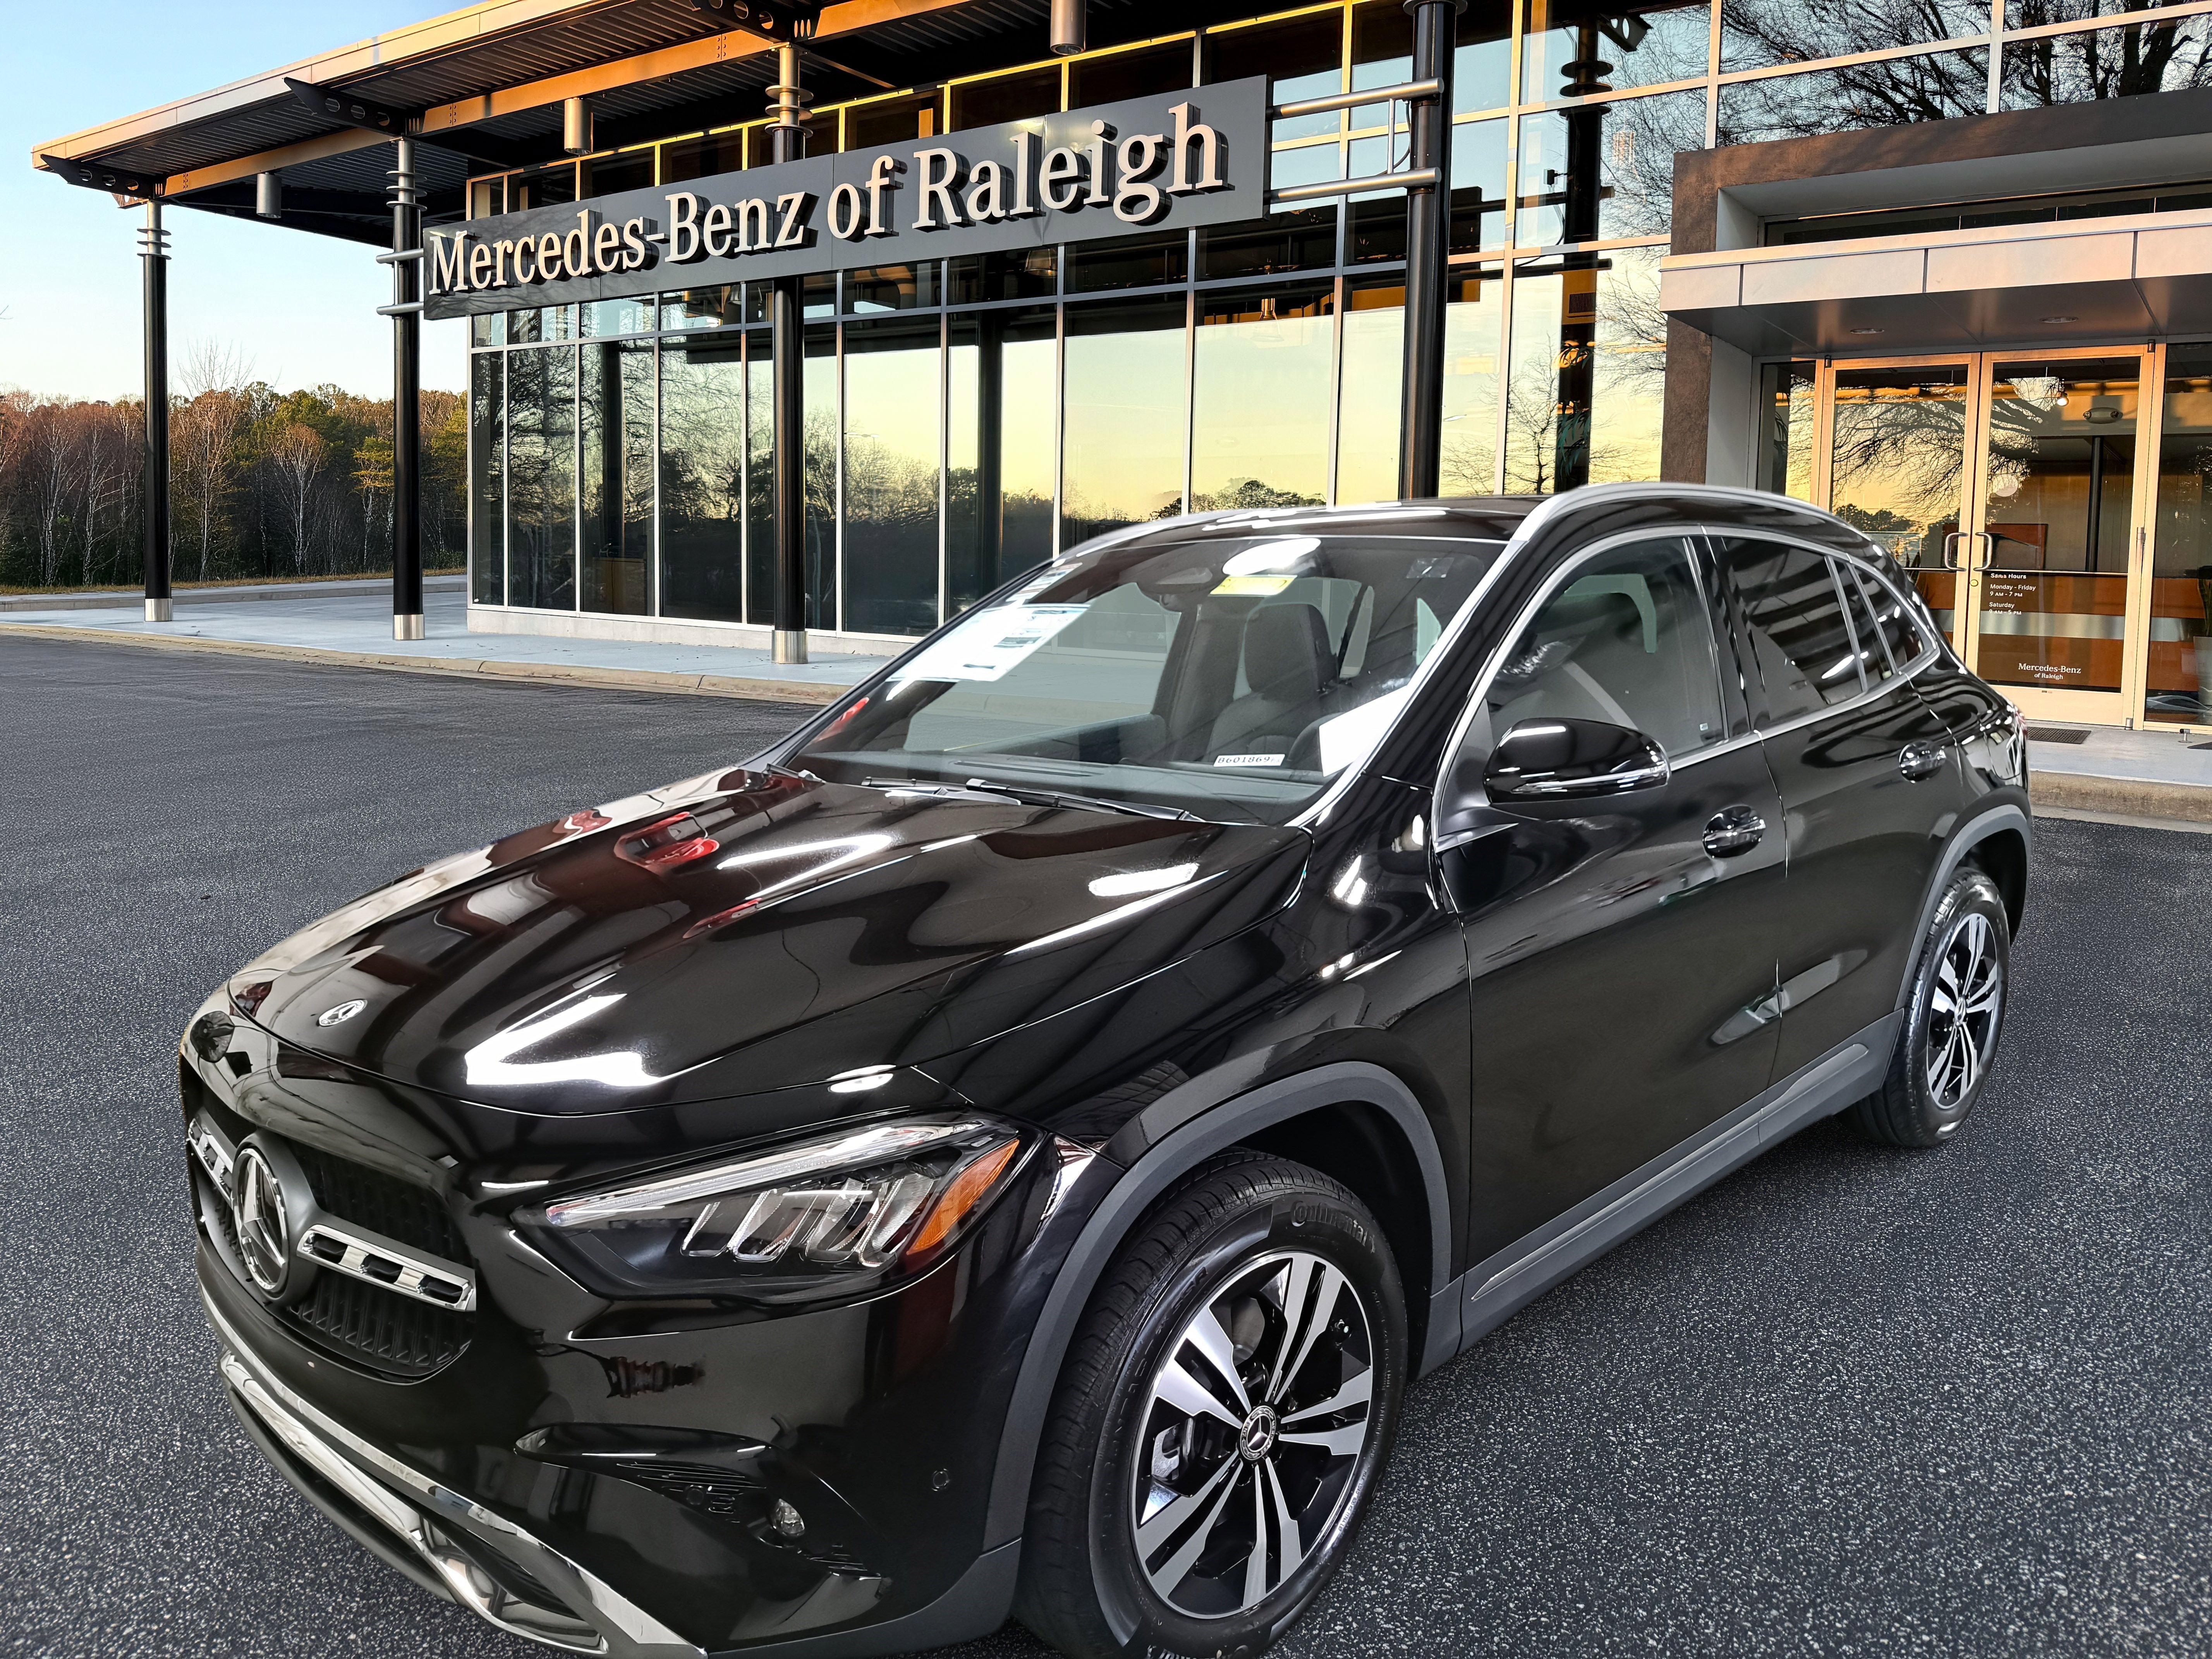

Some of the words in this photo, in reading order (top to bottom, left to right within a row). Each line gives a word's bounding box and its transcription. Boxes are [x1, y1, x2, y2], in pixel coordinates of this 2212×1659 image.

[428, 191, 807, 295] Mercedes-Benz
[828, 155, 895, 240] of
[912, 101, 1224, 223] Raleigh
[2018, 663, 2081, 673] Mercedes-Benz
